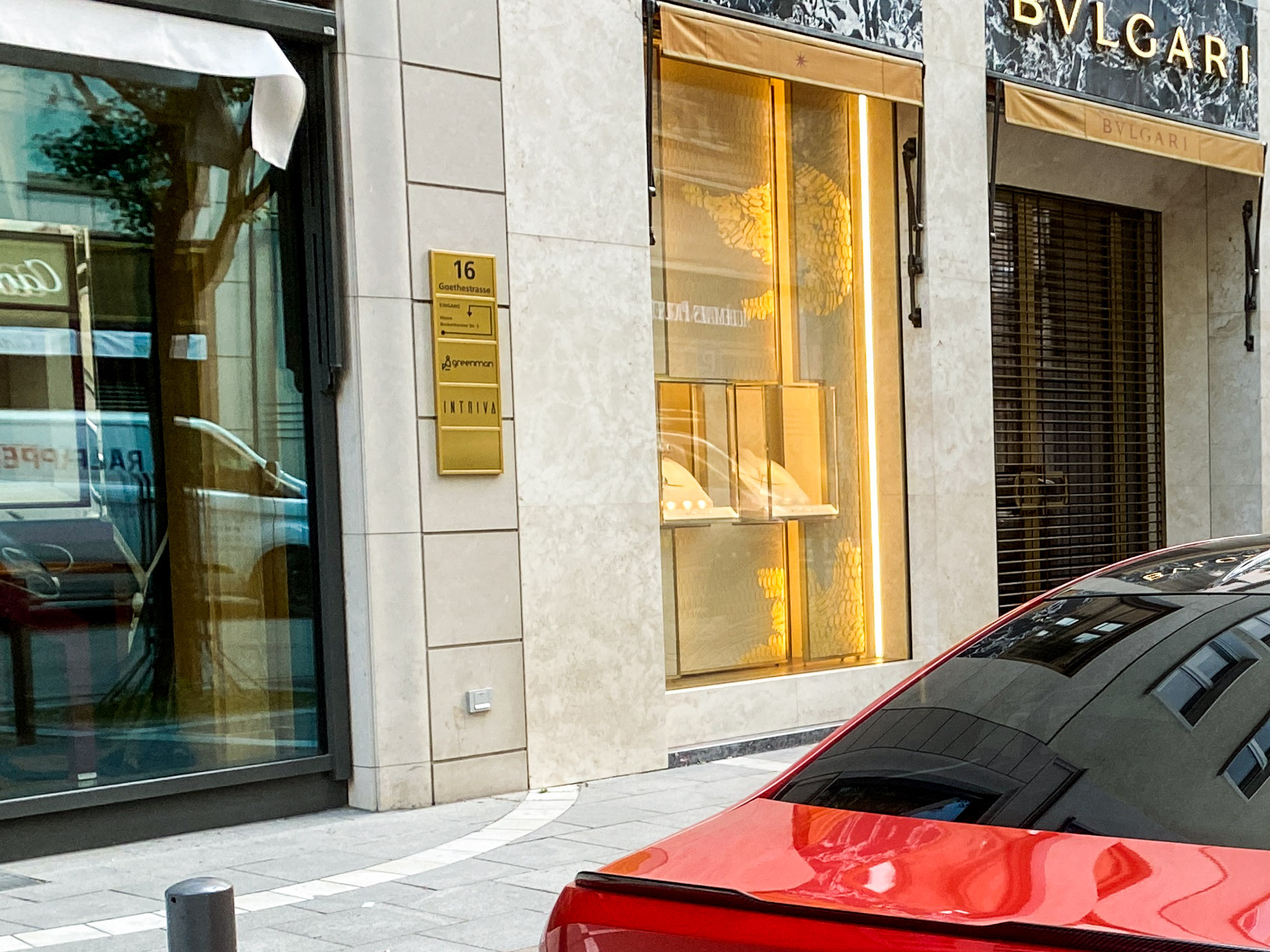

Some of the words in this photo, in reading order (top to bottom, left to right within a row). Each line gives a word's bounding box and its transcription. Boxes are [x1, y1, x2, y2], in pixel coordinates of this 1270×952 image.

[1013, 0, 1249, 84] BVLGARI
[1102, 118, 1188, 151] BVLGARI
[453, 259, 476, 280] 16
[438, 282, 491, 294] Goethestrasse
[452, 359, 494, 368] greenman
[443, 400, 497, 414] INTRIVA
